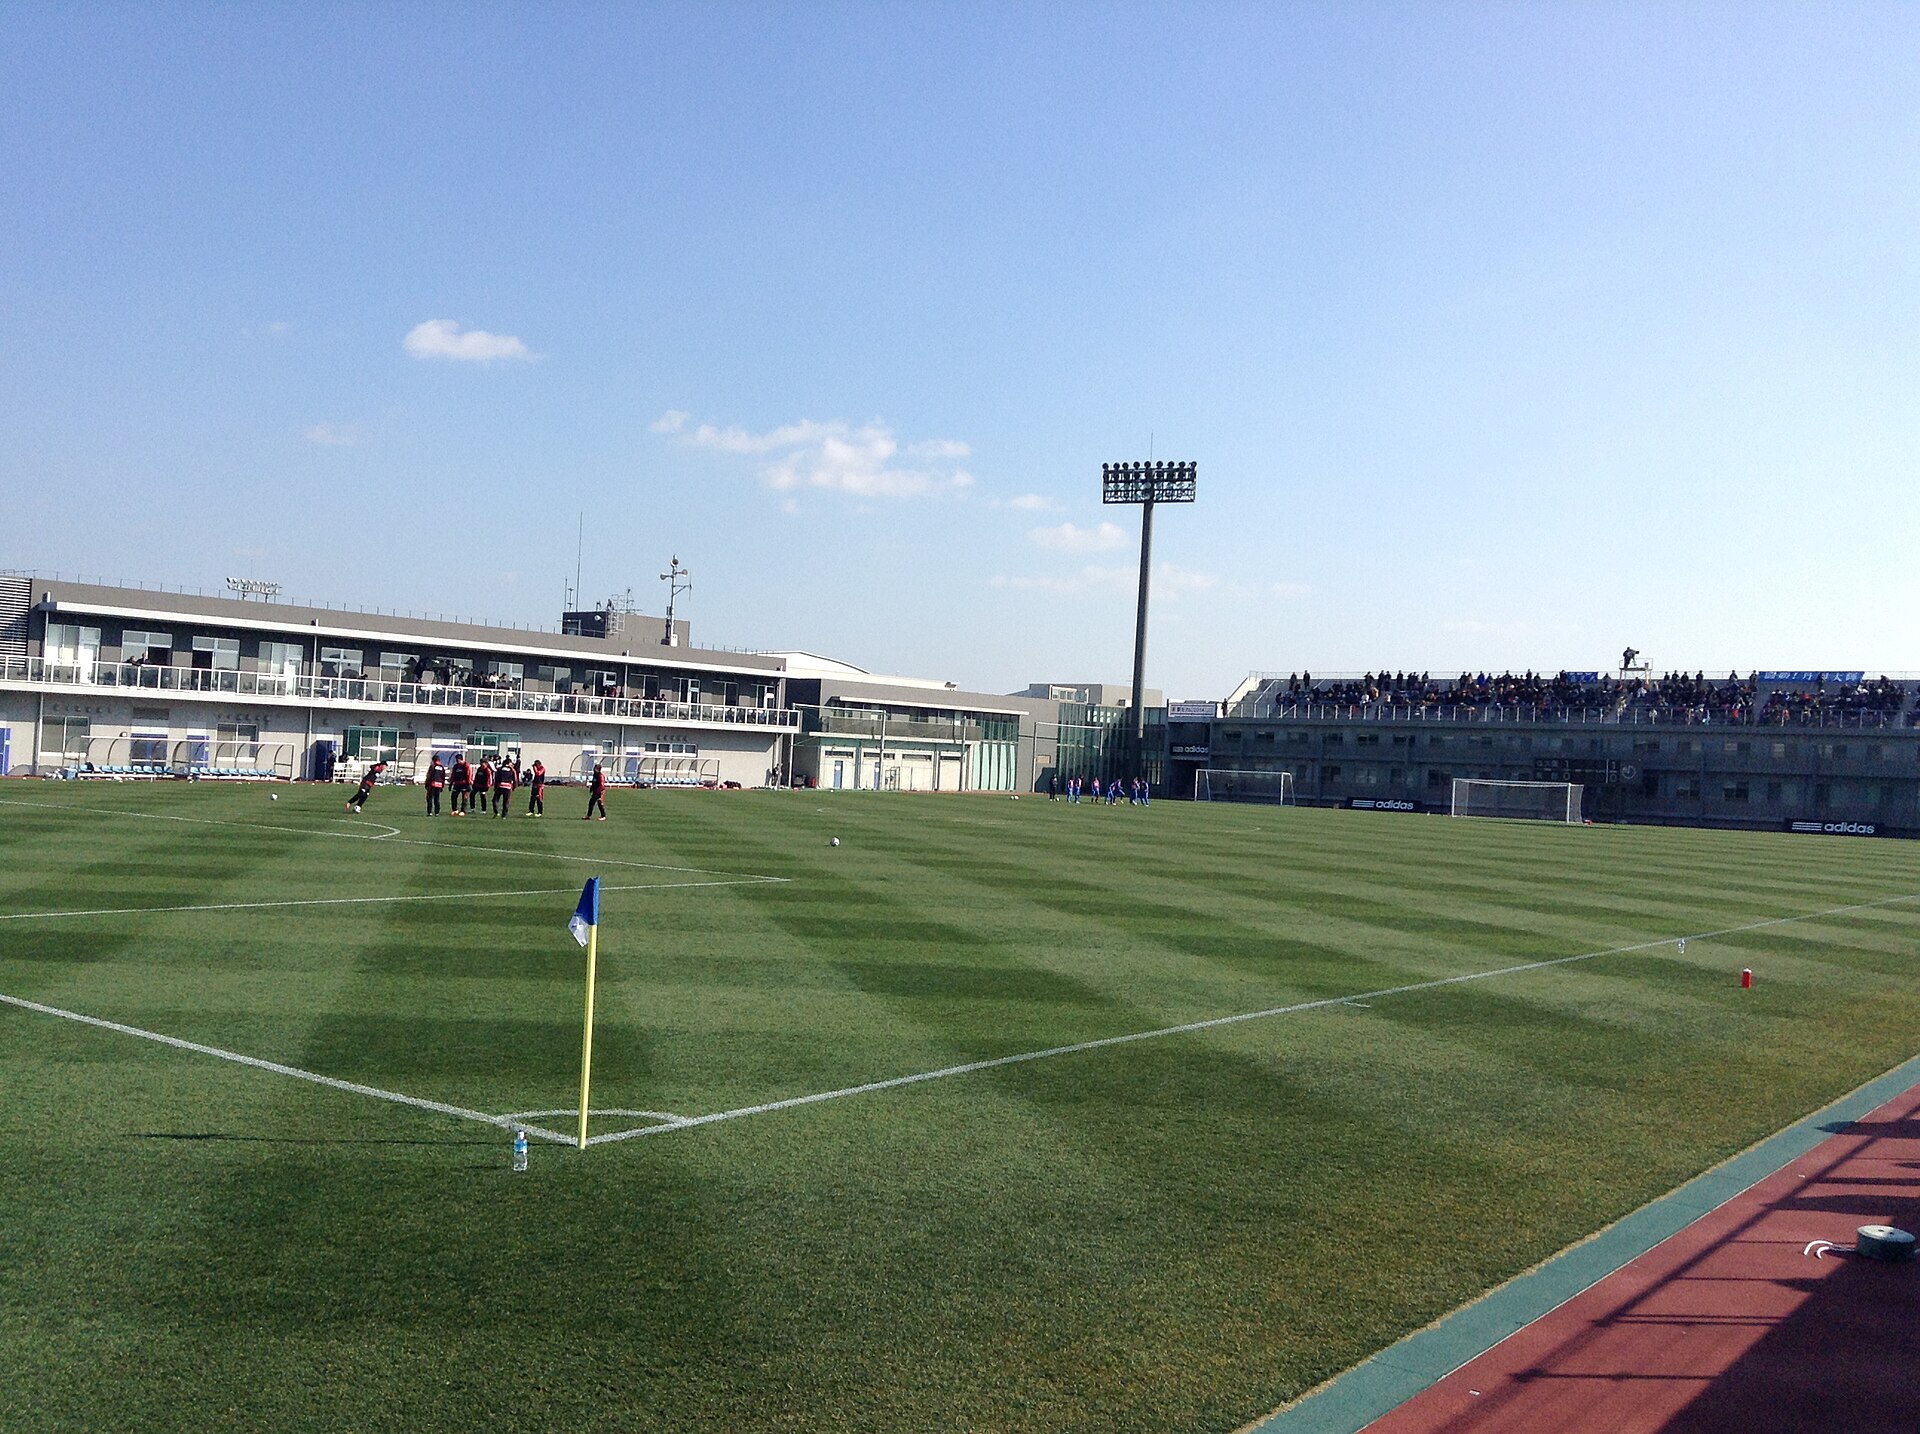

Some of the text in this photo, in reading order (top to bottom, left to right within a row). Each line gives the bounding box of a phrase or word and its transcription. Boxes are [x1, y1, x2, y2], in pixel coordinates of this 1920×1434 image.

[1184, 745, 1209, 754] adidas
[1375, 800, 1414, 810] adidas
[1824, 821, 1875, 834] adidas
